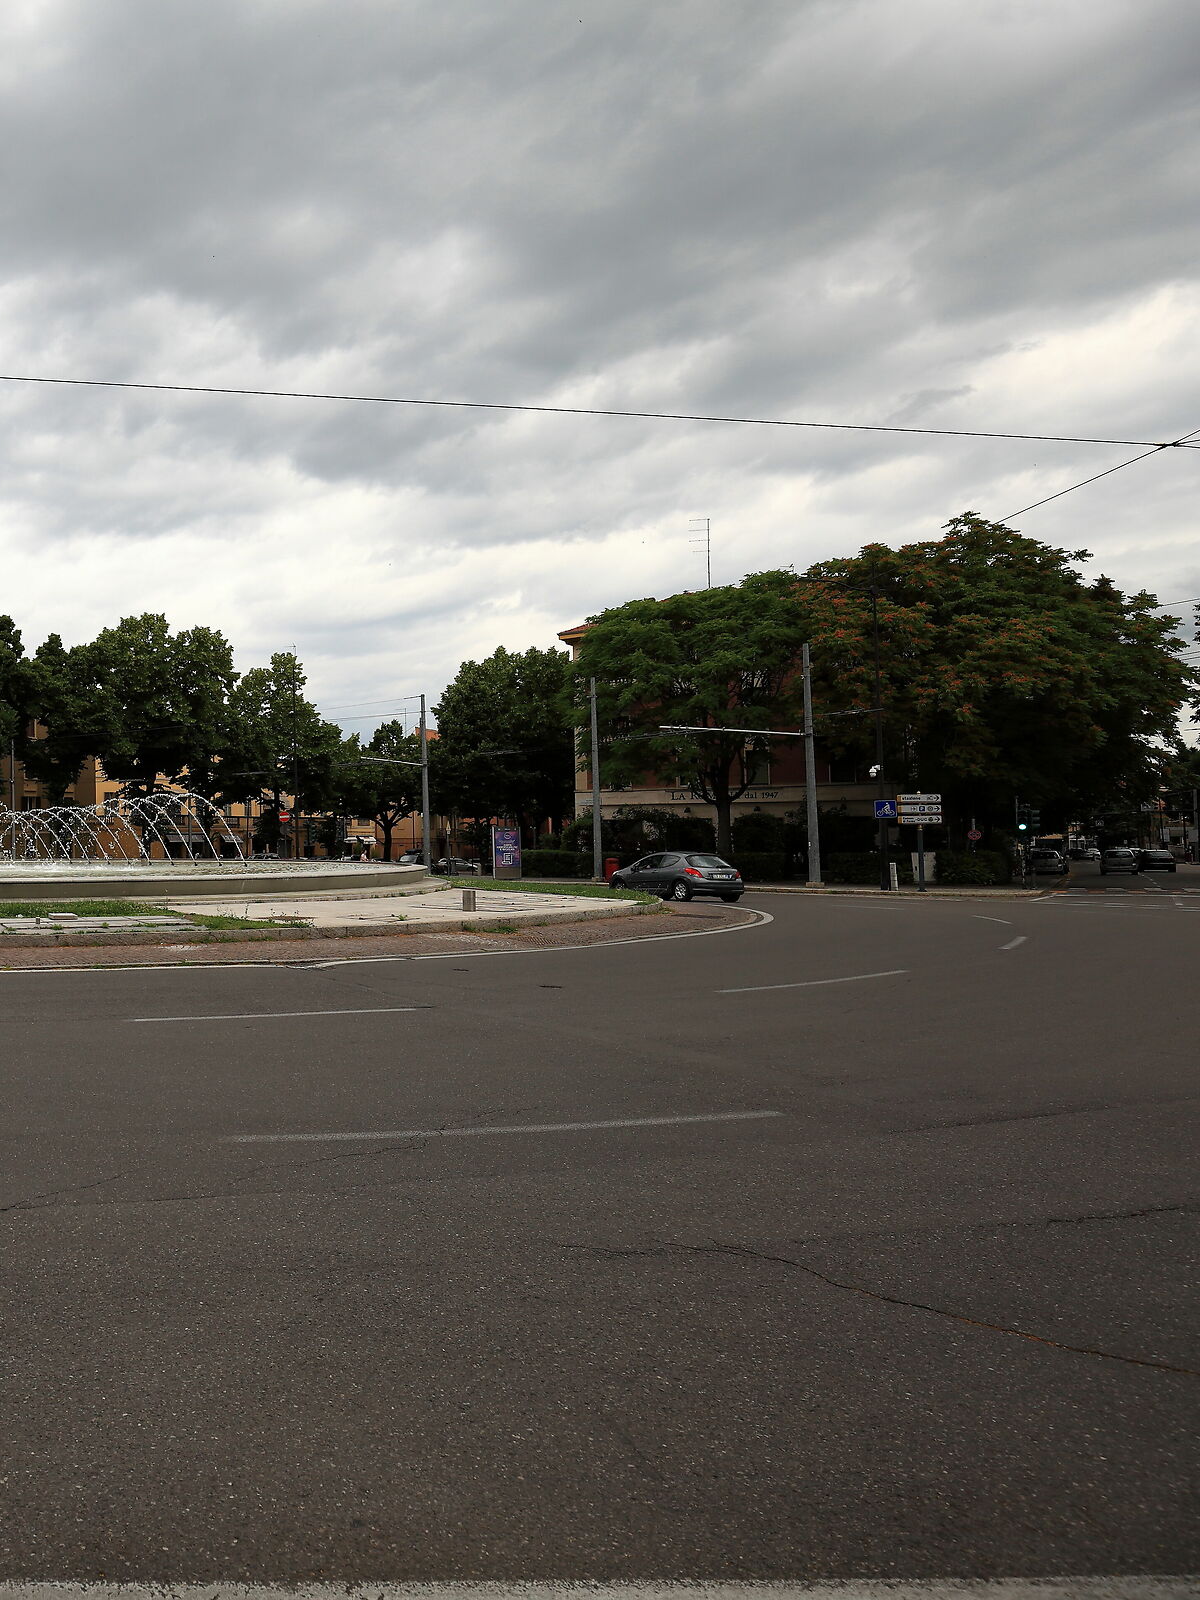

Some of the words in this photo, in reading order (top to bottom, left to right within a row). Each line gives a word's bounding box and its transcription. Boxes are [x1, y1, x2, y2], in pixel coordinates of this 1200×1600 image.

[671, 791, 686, 800] LA
[744, 791, 757, 799] dal
[761, 791, 779, 799] 1947
